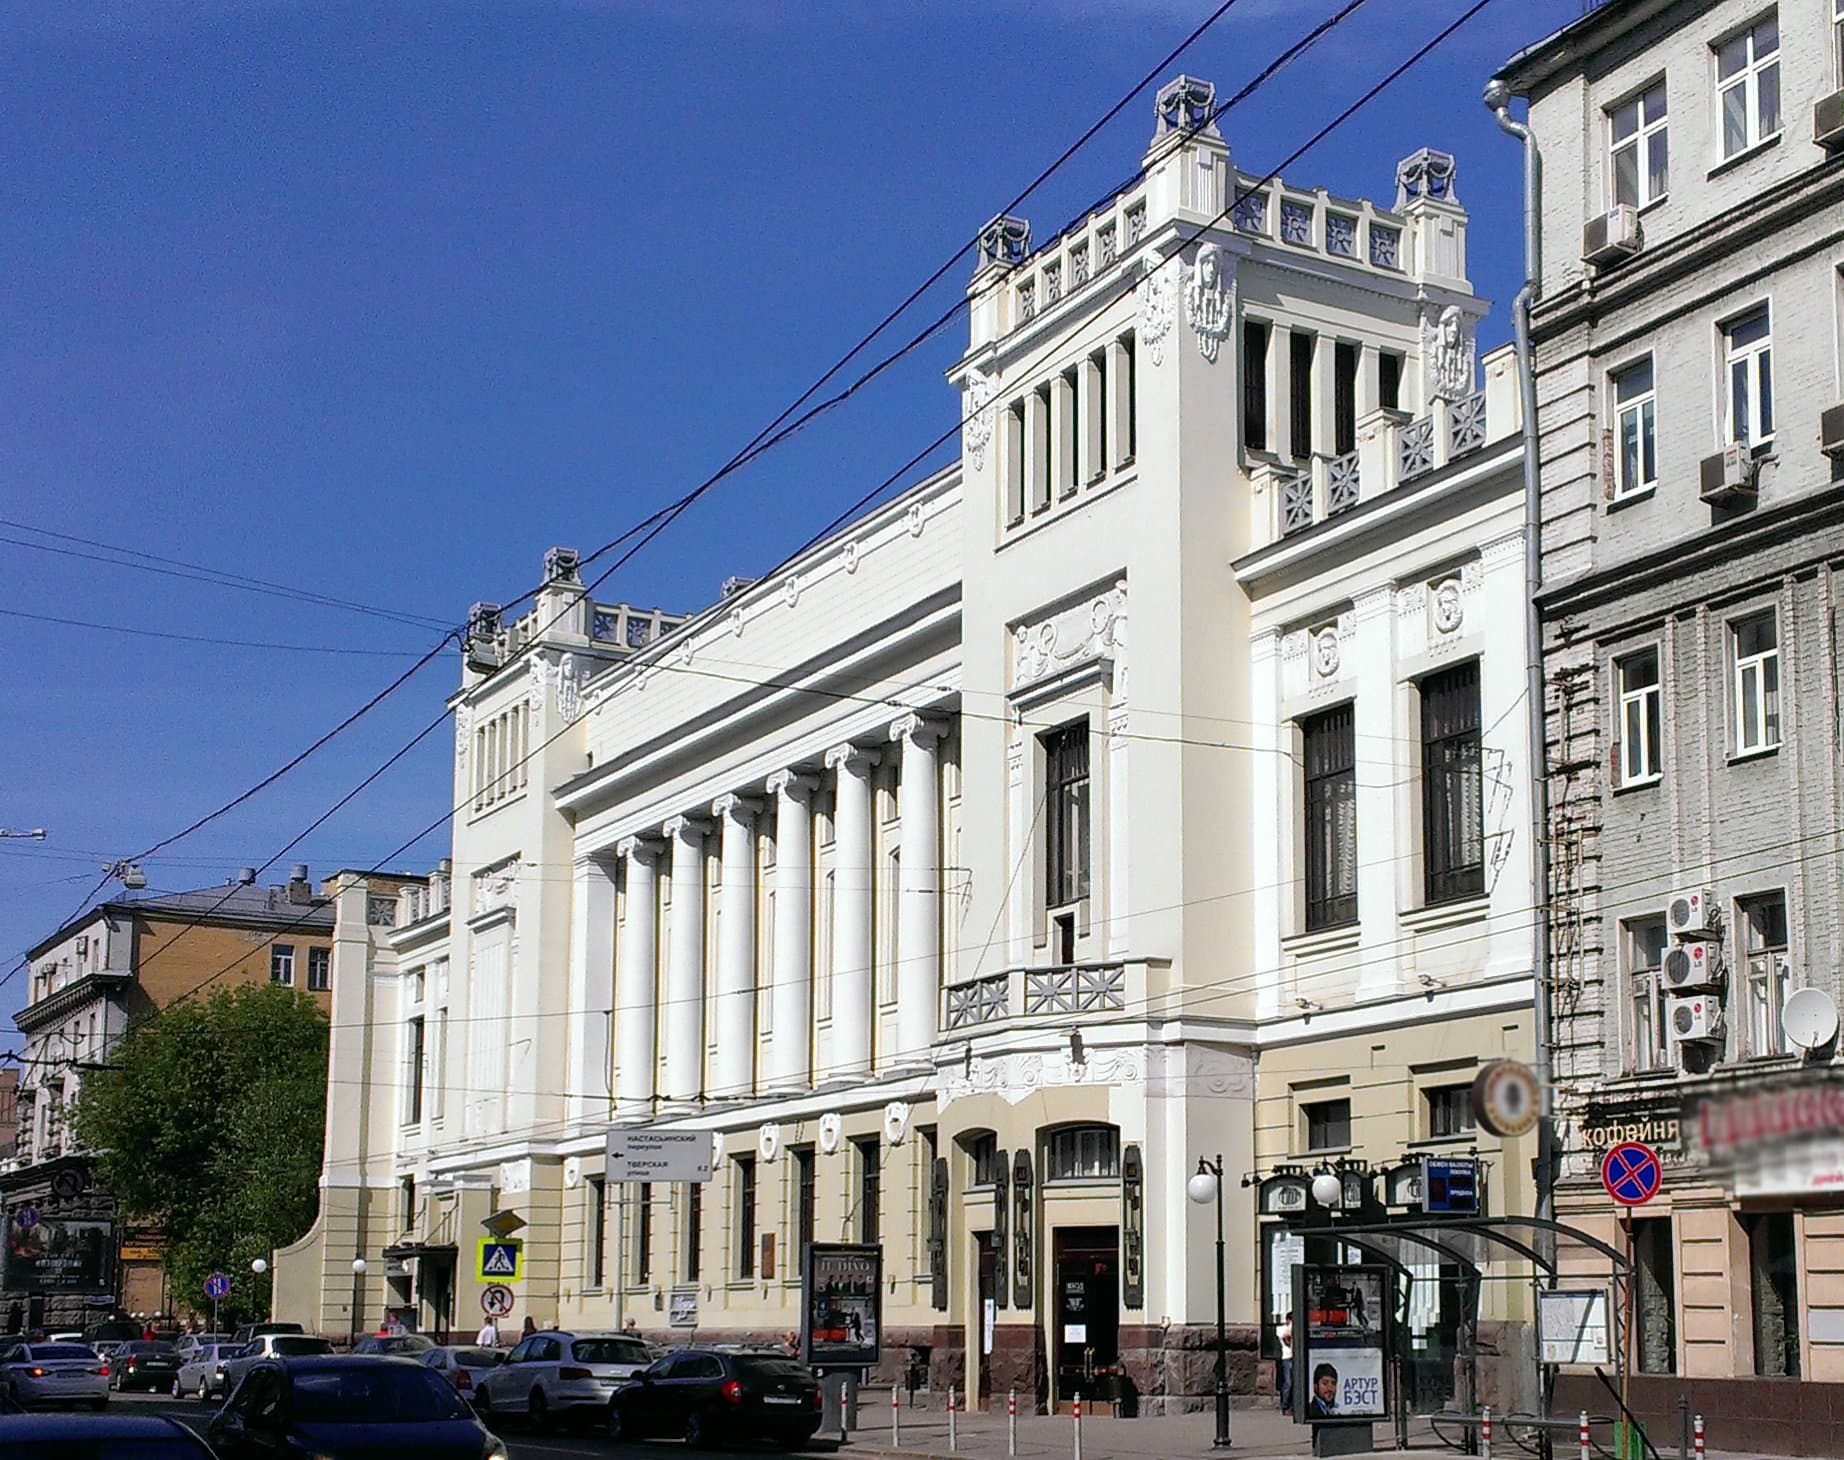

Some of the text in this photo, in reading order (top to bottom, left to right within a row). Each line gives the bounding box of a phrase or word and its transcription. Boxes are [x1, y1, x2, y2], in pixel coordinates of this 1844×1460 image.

[1582, 1117, 1679, 1149] кофейня
[1343, 1377, 1378, 1390] АРТУР
[1343, 1390, 1378, 1405] БЭСТ
